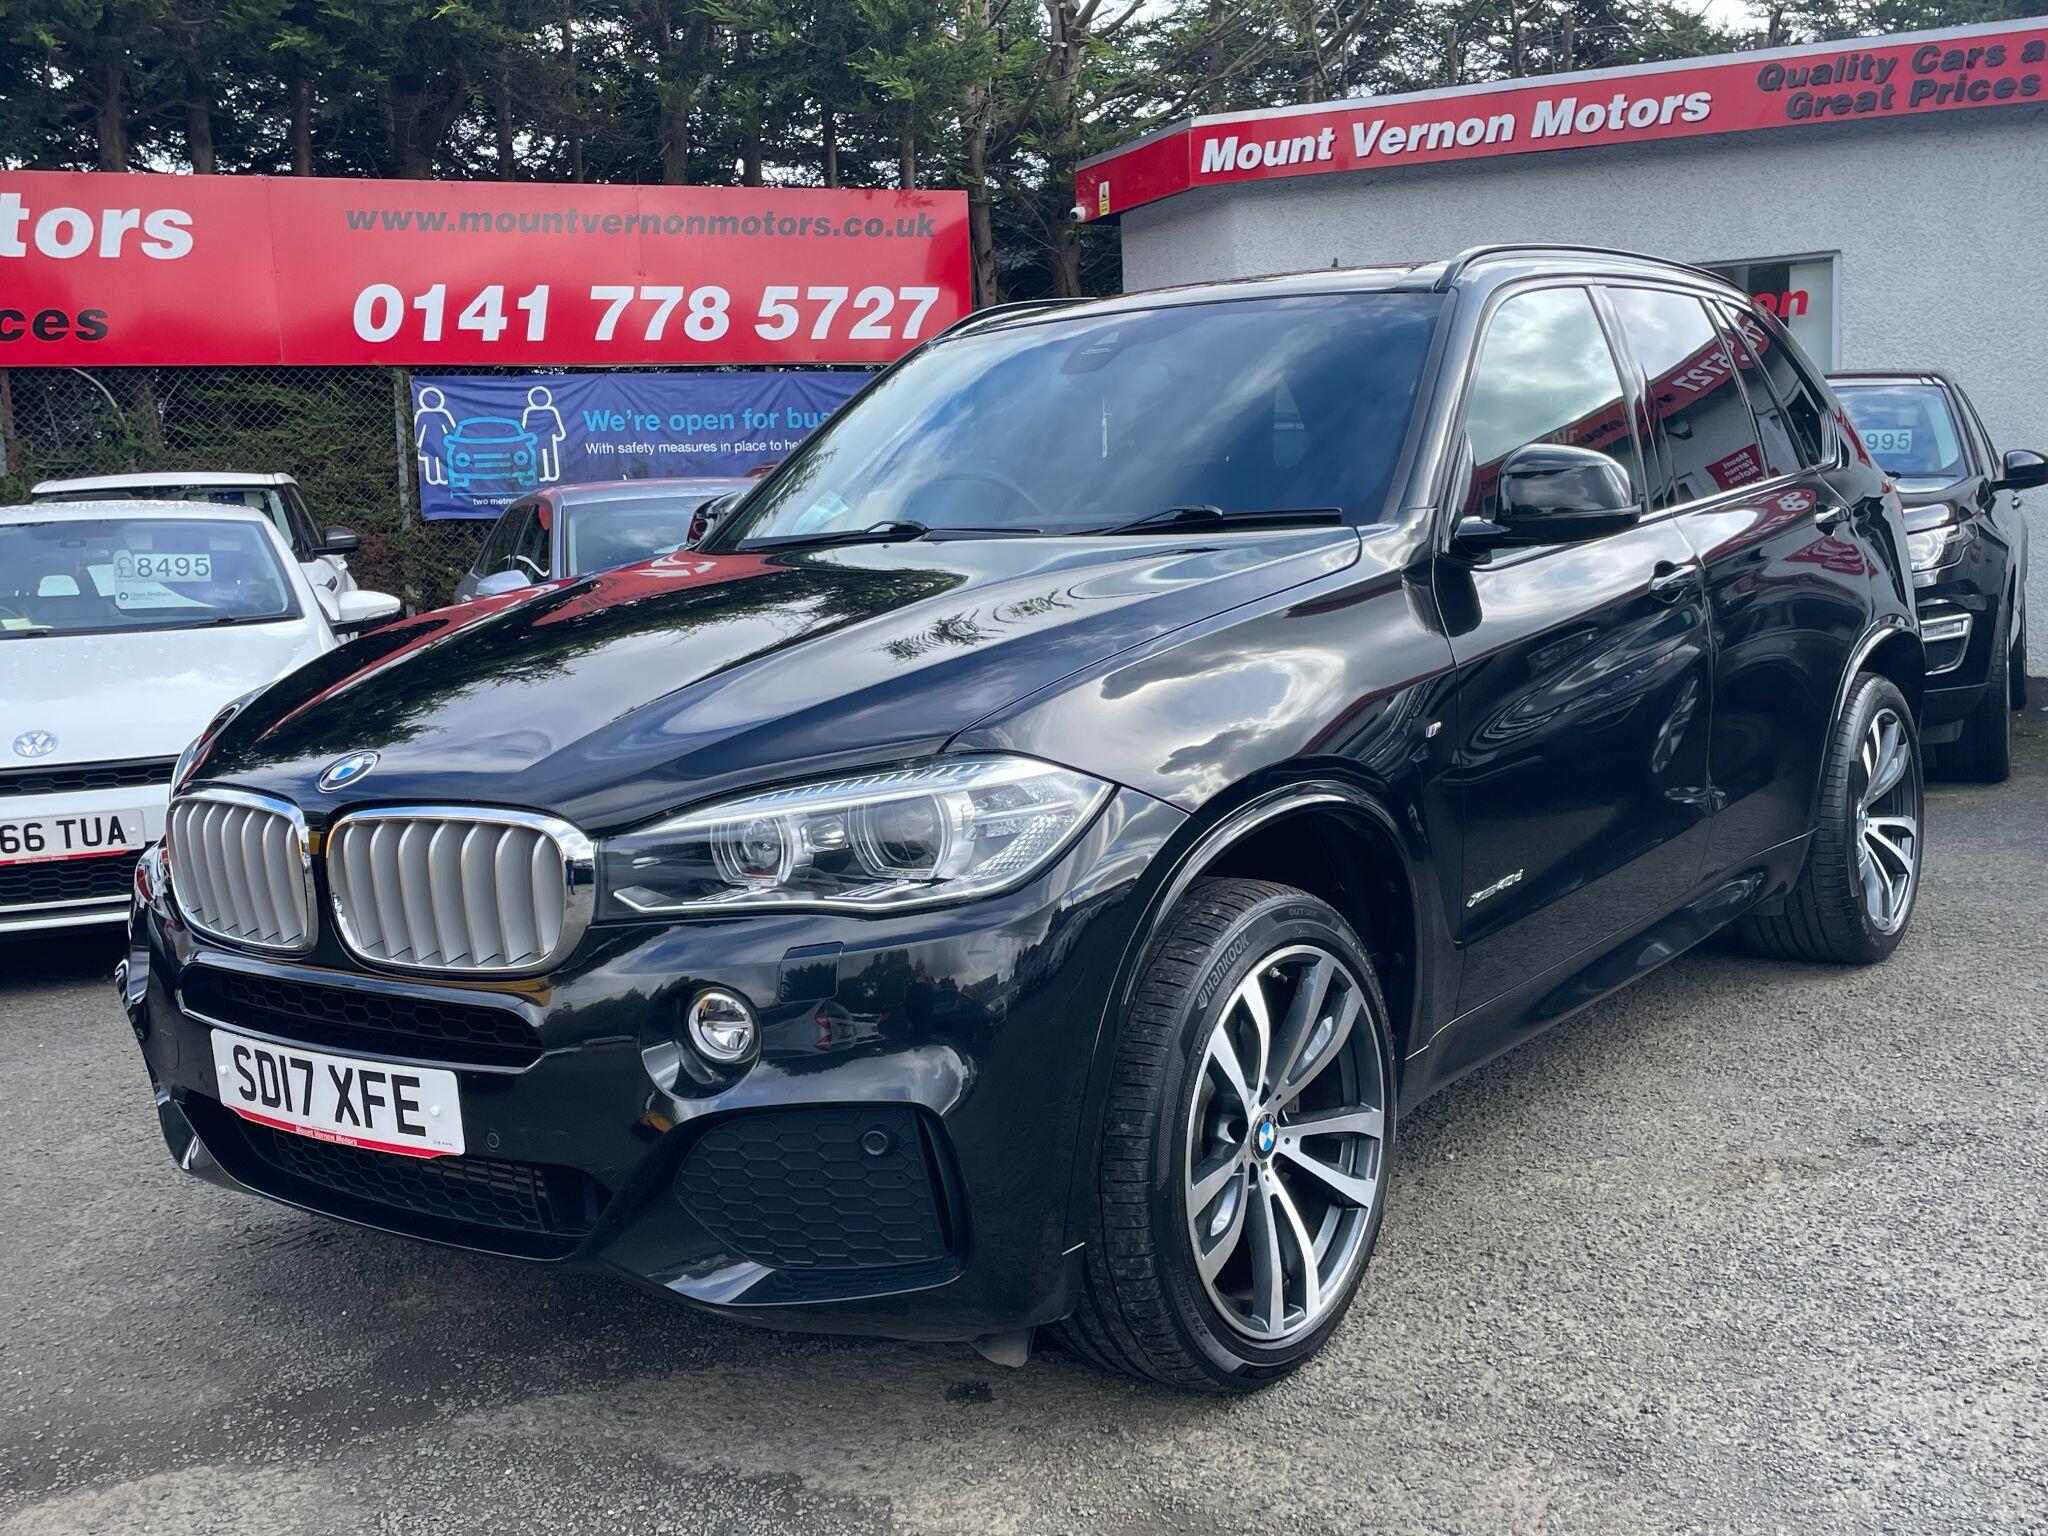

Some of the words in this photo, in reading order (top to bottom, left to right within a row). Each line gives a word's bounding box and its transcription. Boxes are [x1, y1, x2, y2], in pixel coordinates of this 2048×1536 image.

[1757, 54, 1898, 91] Quality
[1911, 44, 2006, 74] Cars
[1786, 84, 1896, 119] Great
[1909, 73, 2041, 108] Prices
[1200, 126, 1336, 174] Mount
[1351, 111, 1516, 158] Vernon
[1530, 90, 1713, 140] Motors
[0, 192, 193, 260] tors
[346, 208, 936, 238] www.mountvernonmotors.co.uk
[0, 308, 108, 341] ces
[353, 283, 549, 343] 0141
[590, 285, 730, 342] 778
[754, 285, 940, 341] 5727
[669, 411, 735, 436] open
[741, 408, 779, 430] for
[585, 442, 614, 455] With
[618, 441, 655, 456] safety
[659, 442, 717, 454] measures
[720, 440, 731, 452] in
[734, 440, 766, 457] place
[769, 440, 782, 451] to
[0, 822, 46, 854] 66
[56, 816, 127, 849] TUA
[233, 1044, 314, 1117] SD17
[327, 1064, 426, 1137] XFE
